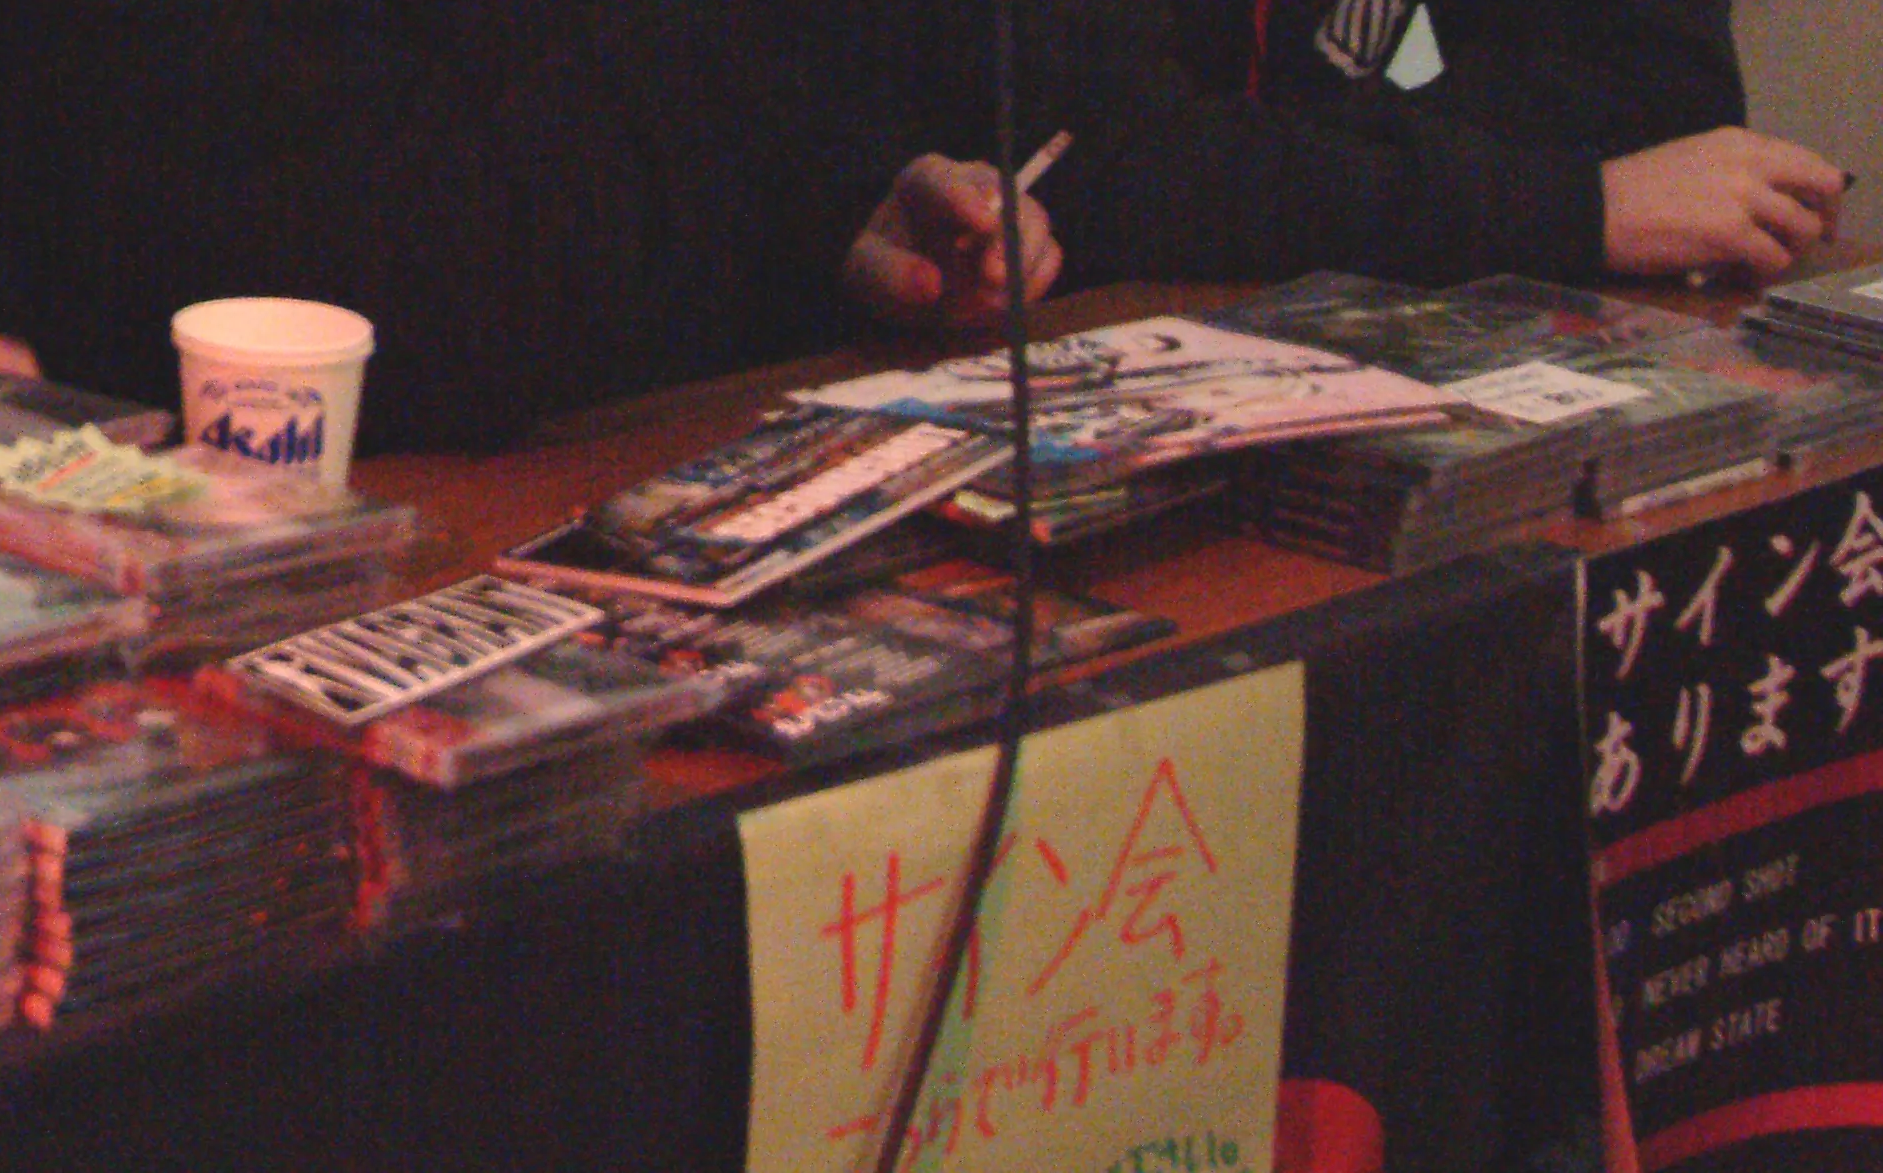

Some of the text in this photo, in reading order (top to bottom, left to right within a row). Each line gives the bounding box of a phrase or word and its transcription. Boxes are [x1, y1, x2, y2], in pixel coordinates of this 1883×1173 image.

[199, 410, 325, 465] Asahi
[1598, 490, 1883, 680] サイン会
[1589, 625, 1883, 818] あります
[1641, 954, 1711, 1010] NEVER
[1799, 912, 1841, 954] OF
[1709, 996, 1786, 1052] STATE
